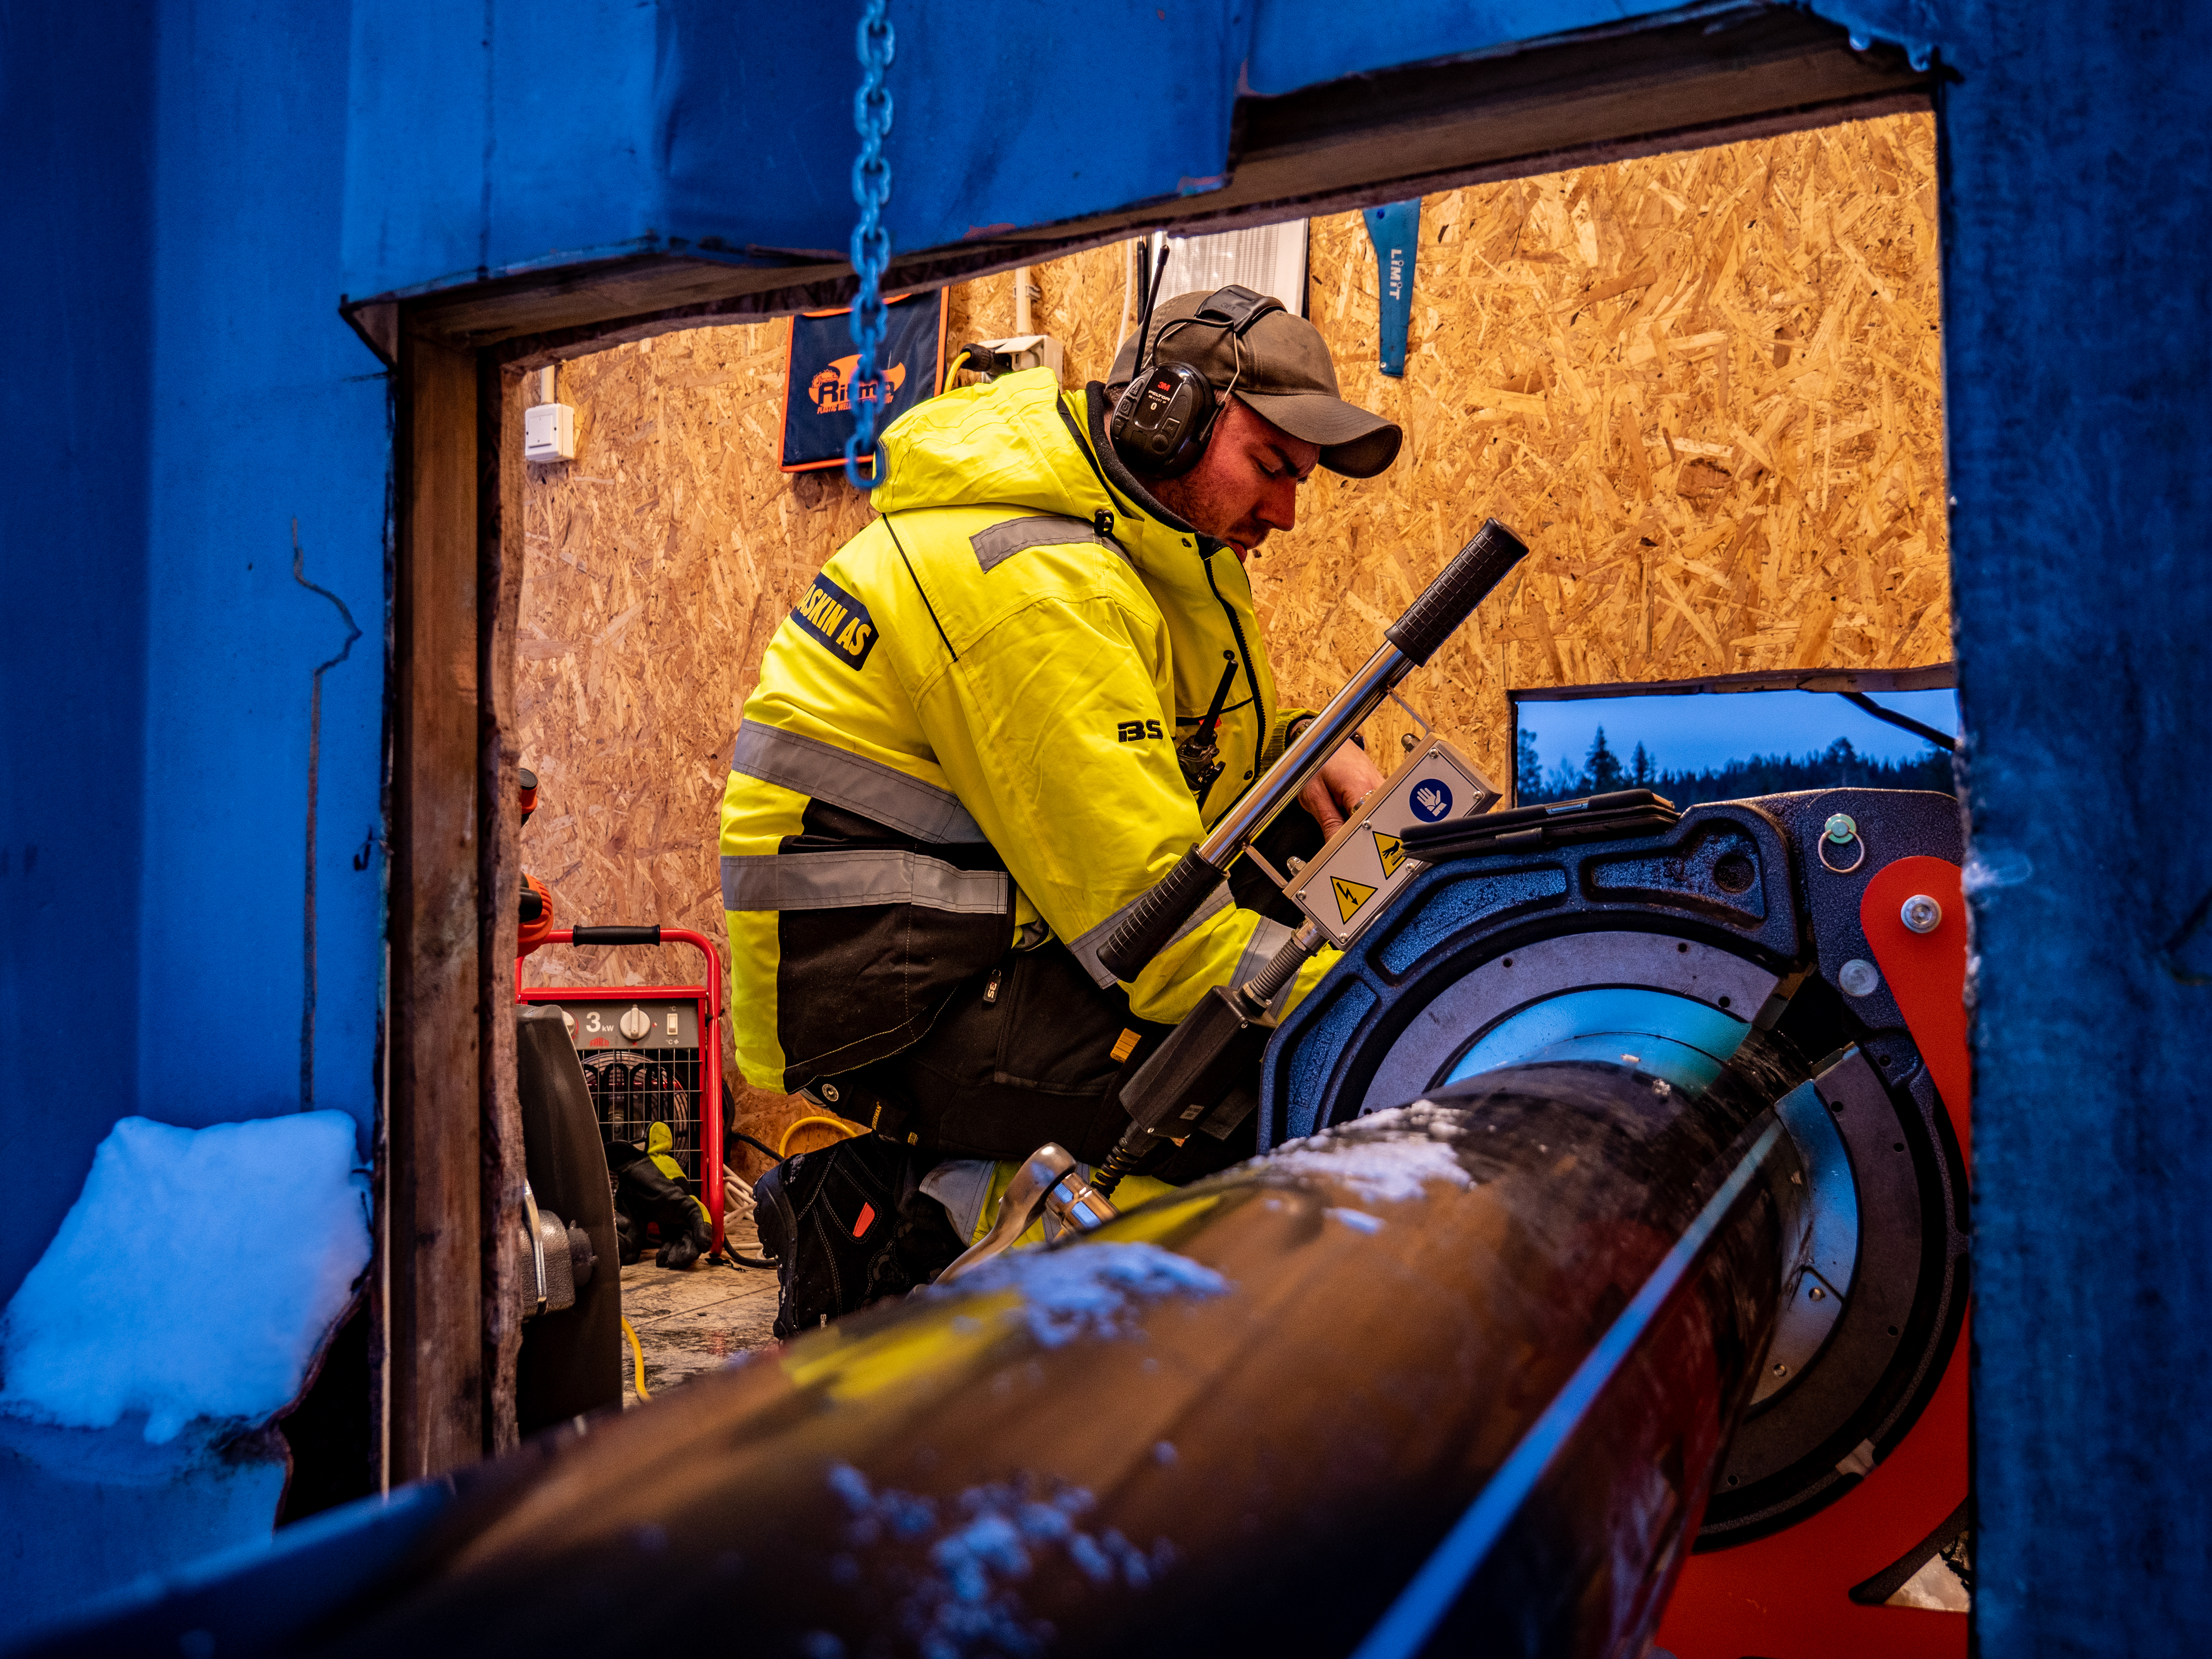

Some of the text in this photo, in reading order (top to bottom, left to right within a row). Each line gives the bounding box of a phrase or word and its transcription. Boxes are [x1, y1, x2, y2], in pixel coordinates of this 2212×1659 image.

[1158, 381, 1171, 391] 3M
[1148, 390, 1171, 401] PELTOR
[817, 404, 837, 415] PLASTIC
[796, 582, 872, 656] ASKIN AS
[586, 1011, 601, 1032] 3
